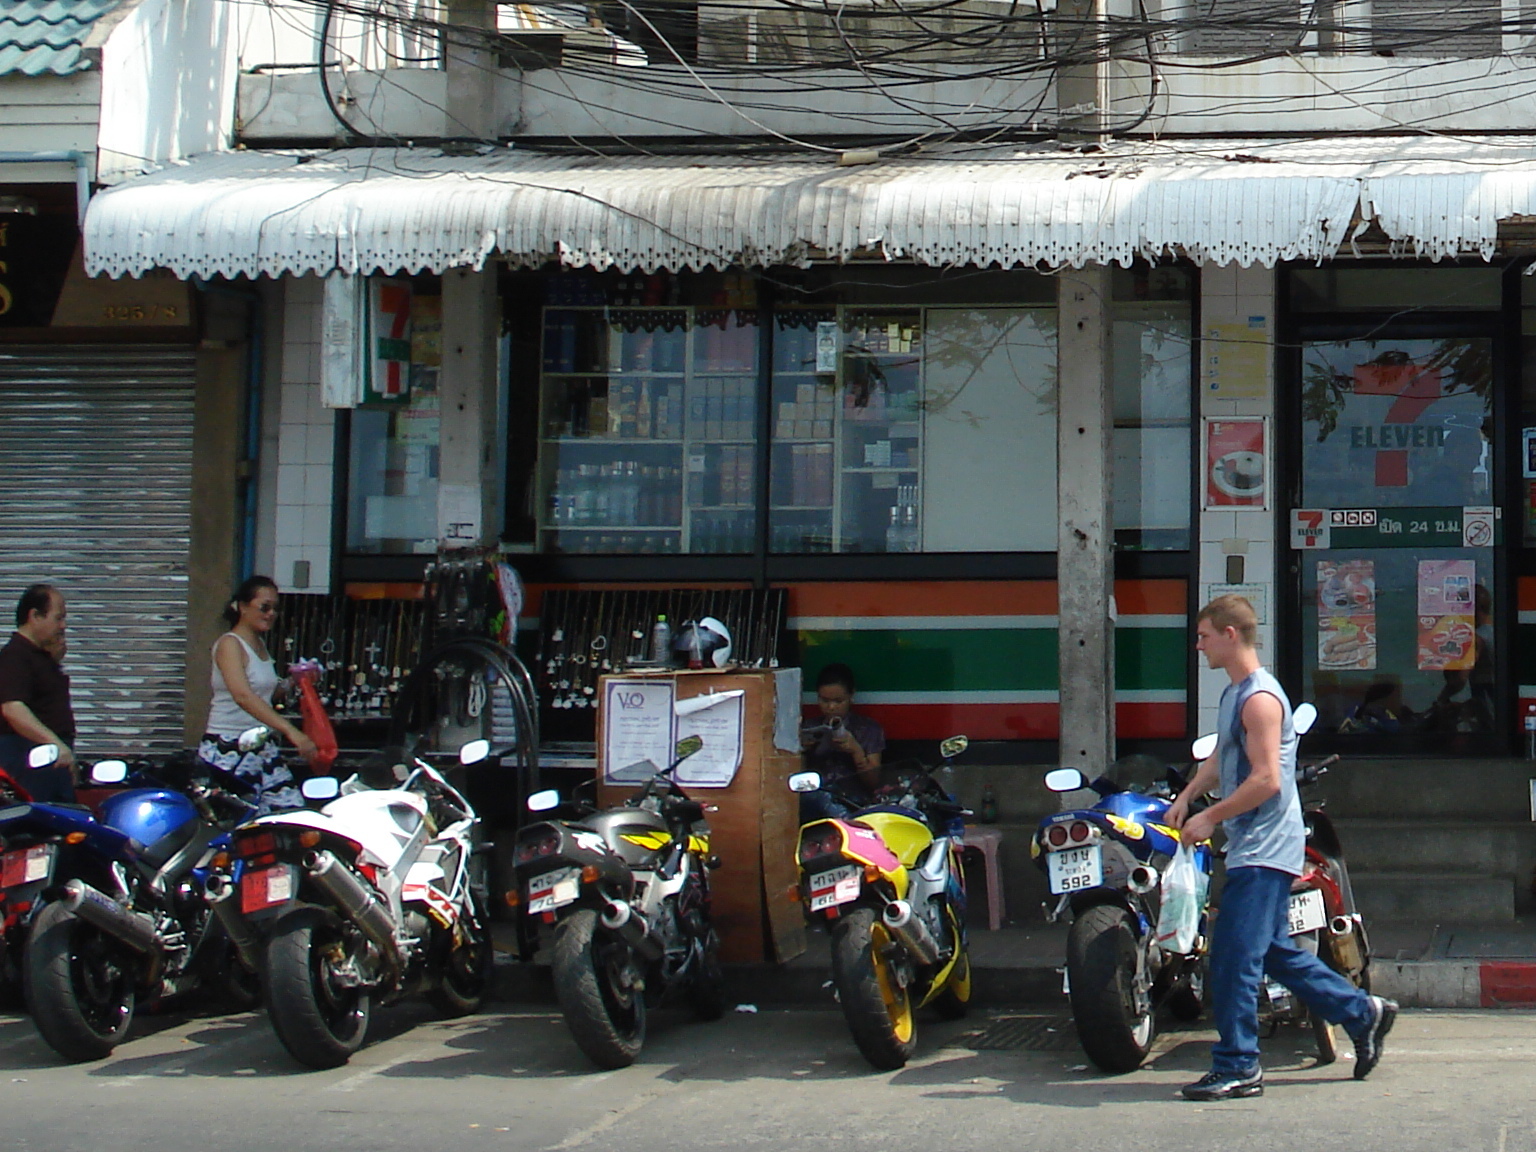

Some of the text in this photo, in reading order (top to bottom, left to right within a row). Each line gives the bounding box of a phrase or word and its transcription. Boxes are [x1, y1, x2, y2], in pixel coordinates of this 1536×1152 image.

[1353, 364, 1441, 487] 7
[1298, 511, 1323, 547] 7
[1379, 517, 1402, 534] เปิด
[1409, 521, 1428, 533] 24
[1062, 874, 1091, 891] 592
